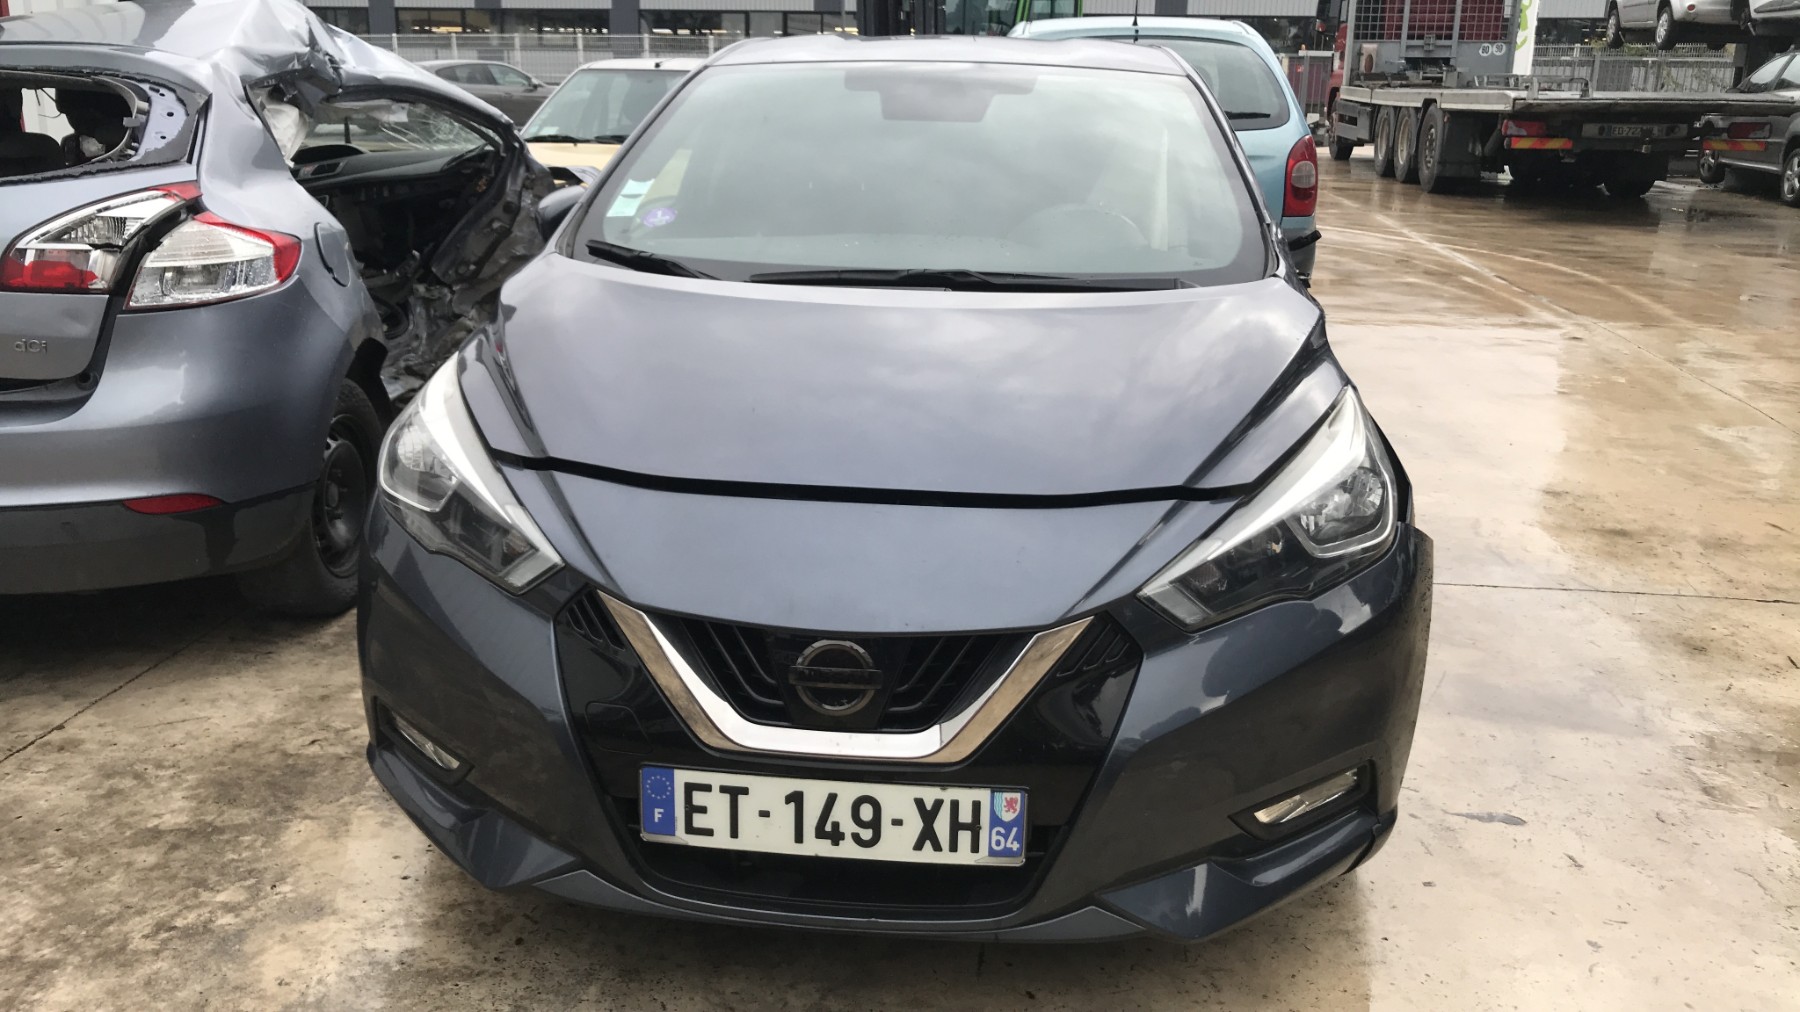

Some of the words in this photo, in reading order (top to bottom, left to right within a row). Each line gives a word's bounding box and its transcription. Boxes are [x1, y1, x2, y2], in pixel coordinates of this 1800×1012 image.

[654, 808, 664, 823] F
[683, 781, 981, 854] ET-149-XH
[990, 826, 1020, 851] 64
